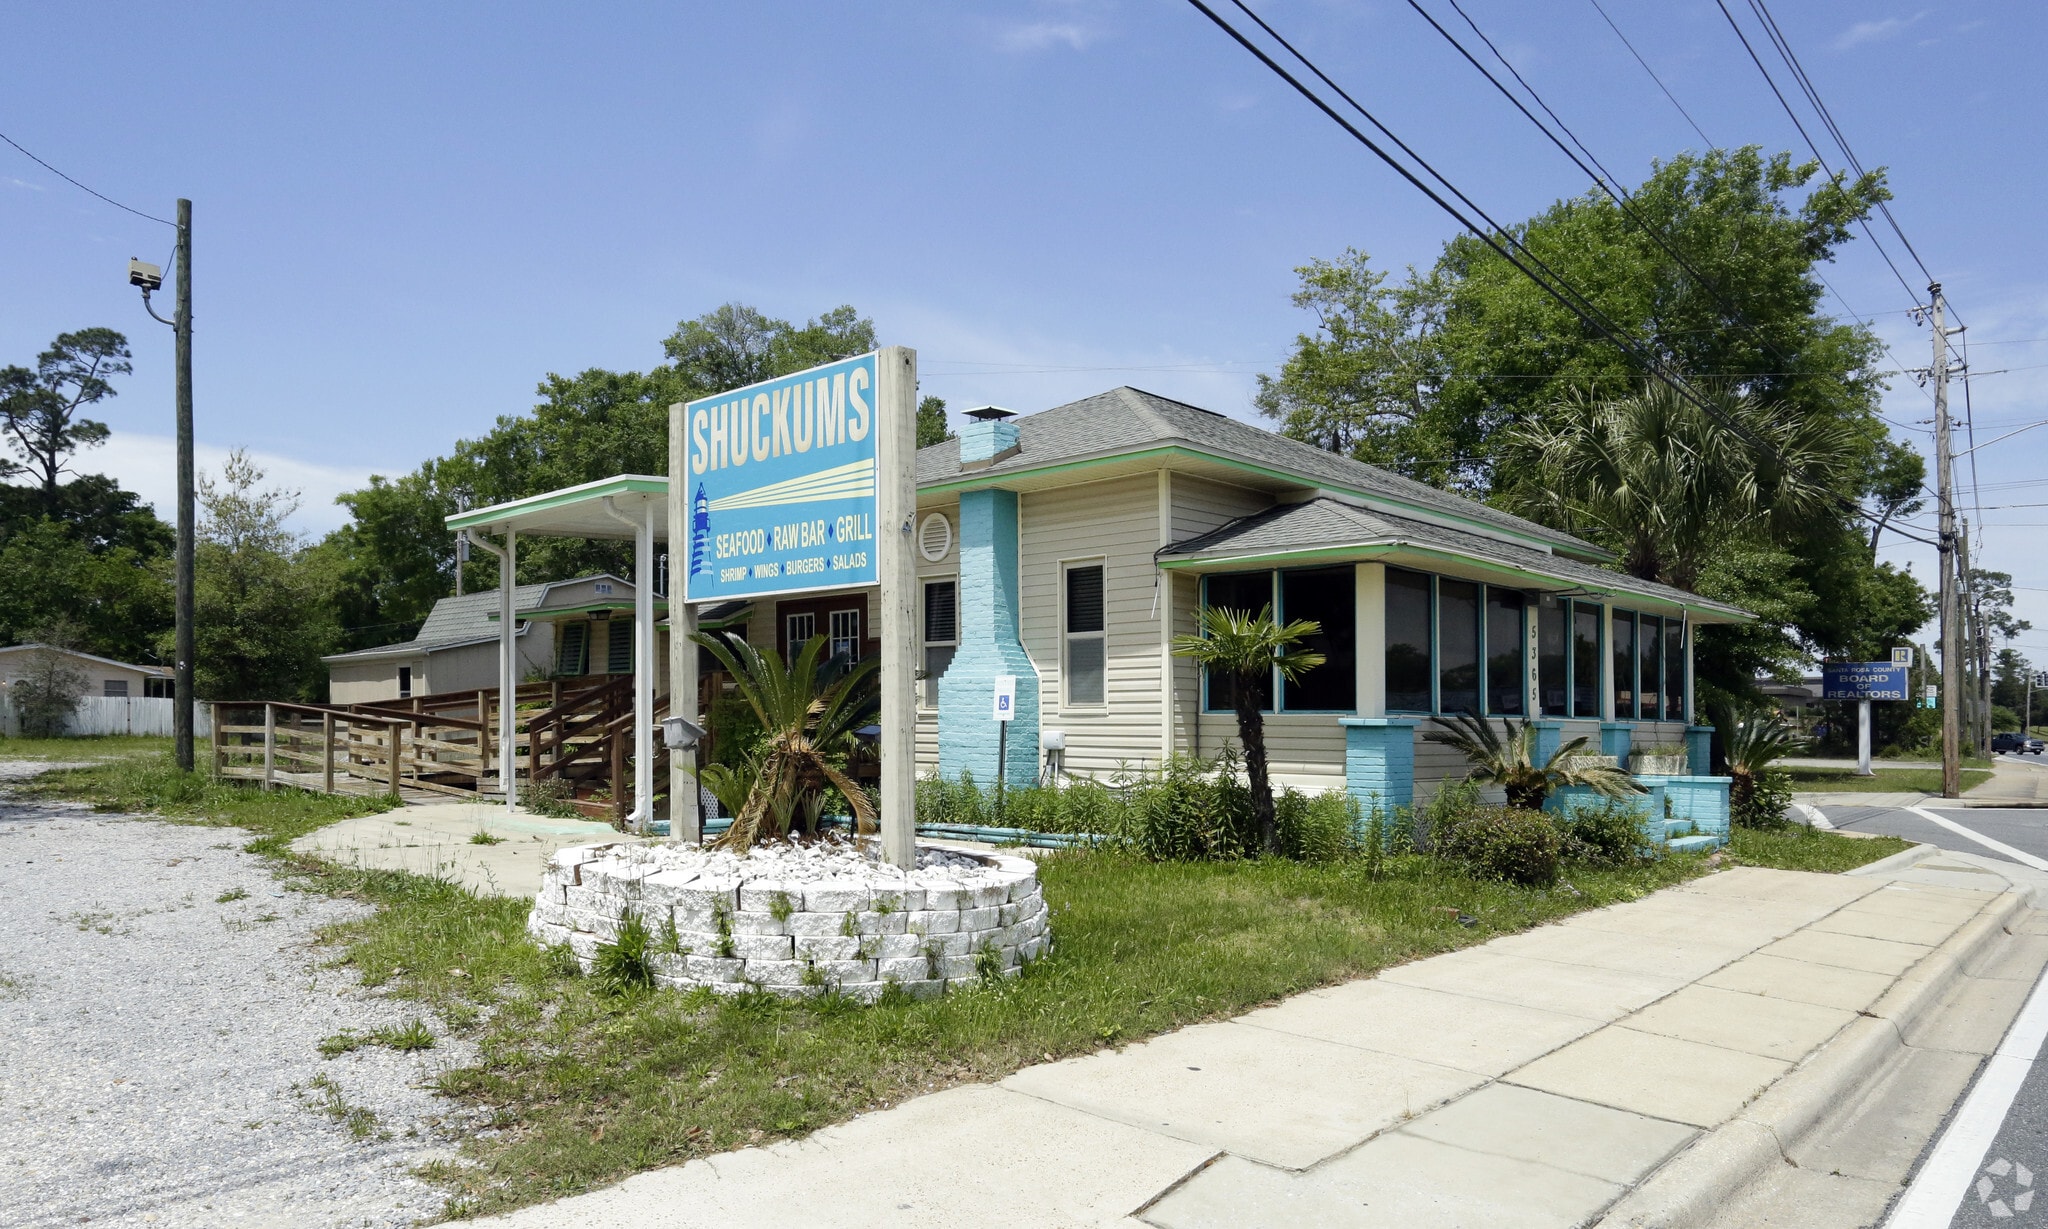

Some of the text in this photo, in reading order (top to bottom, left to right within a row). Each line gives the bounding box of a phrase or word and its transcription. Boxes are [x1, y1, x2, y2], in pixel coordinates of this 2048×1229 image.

[692, 366, 870, 475] SHUCKUMS
[716, 513, 872, 559] SEAFOOD RAW BAR GRILL
[720, 551, 867, 583] SHRIMP WINGS BURGERS SALADS
[1827, 690, 1901, 699] REALTORS
[1839, 674, 1889, 683] BOARD
